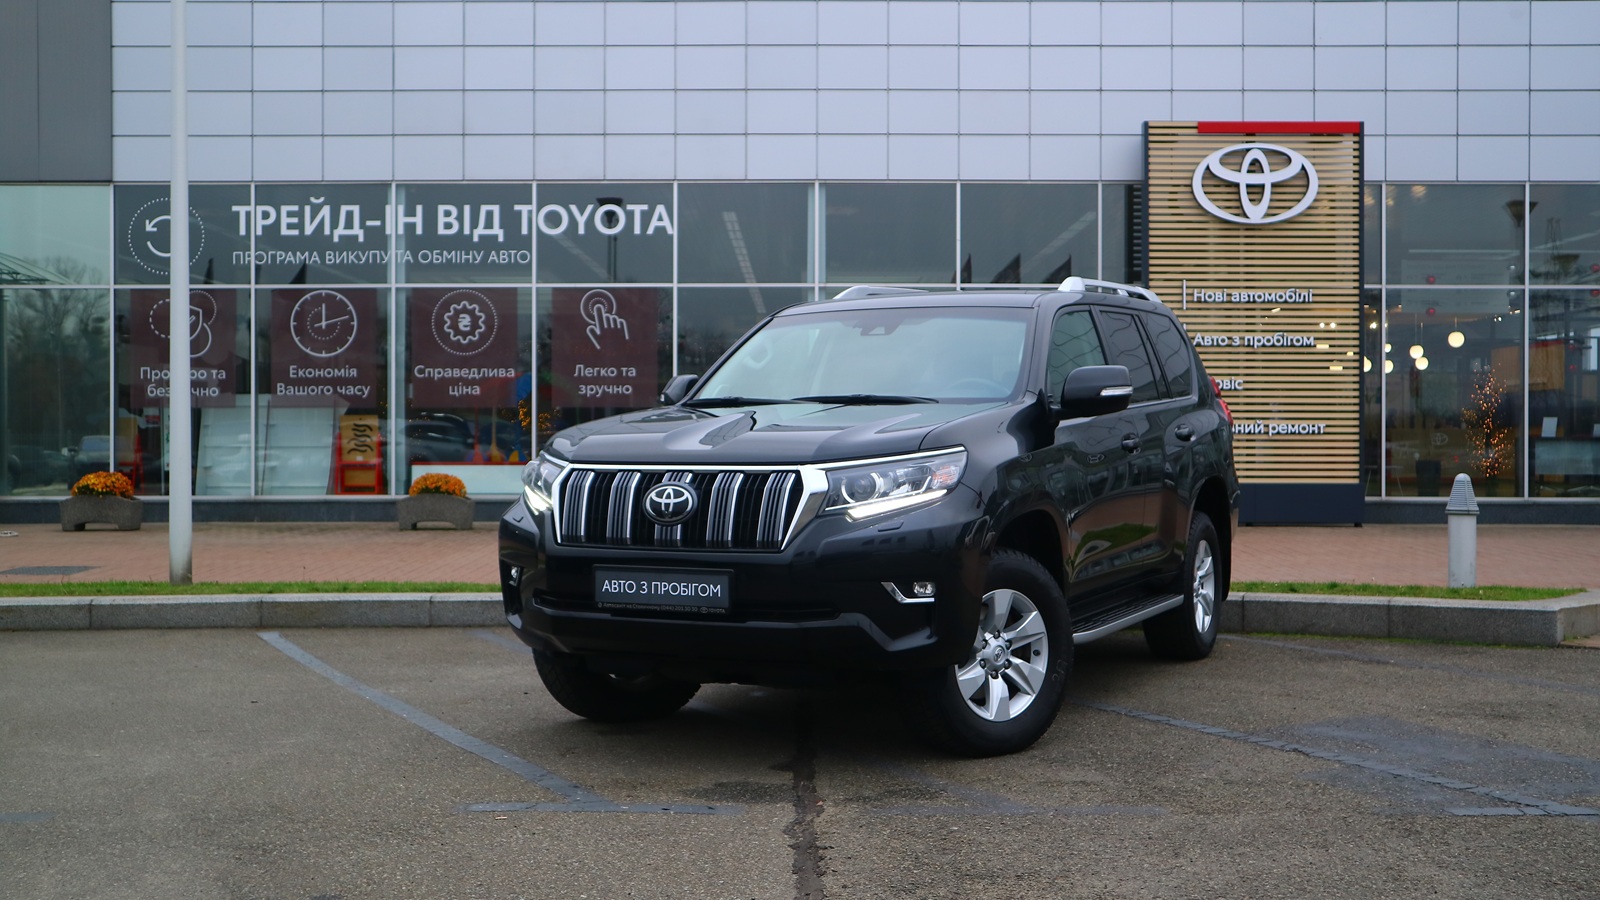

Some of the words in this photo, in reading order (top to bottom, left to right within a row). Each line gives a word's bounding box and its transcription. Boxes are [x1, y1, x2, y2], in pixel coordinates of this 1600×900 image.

[231, 196, 423, 242] ТРЕЙД-ІН
[437, 204, 504, 242] ВІД
[513, 203, 674, 235] TOYOTA
[232, 250, 320, 265] ПРОГРАМА
[325, 250, 389, 265] ВИКУПУ
[395, 250, 414, 264] ТА
[418, 250, 484, 264] ОБМІНУ
[487, 250, 531, 264] АВТО
[1193, 288, 1227, 303] Нові
[1231, 288, 1313, 303] автомобілі
[1193, 333, 1229, 347] Авто
[1231, 336, 1240, 346] з
[1244, 332, 1315, 349] пробігом
[140, 366, 207, 382] Проро
[211, 369, 226, 379] та
[289, 365, 357, 378] Економія
[414, 365, 515, 380] Справедлива
[573, 364, 617, 378] Легко
[620, 367, 636, 377] та
[147, 383, 219, 397] безчно
[276, 383, 332, 396] Вашого
[336, 385, 371, 398] часу
[449, 383, 480, 397] ціна
[578, 383, 632, 397] зручно
[1268, 423, 1326, 437] ремонт
[602, 579, 636, 594] АВТО
[651, 581, 721, 597] ПРОБІГОМ
